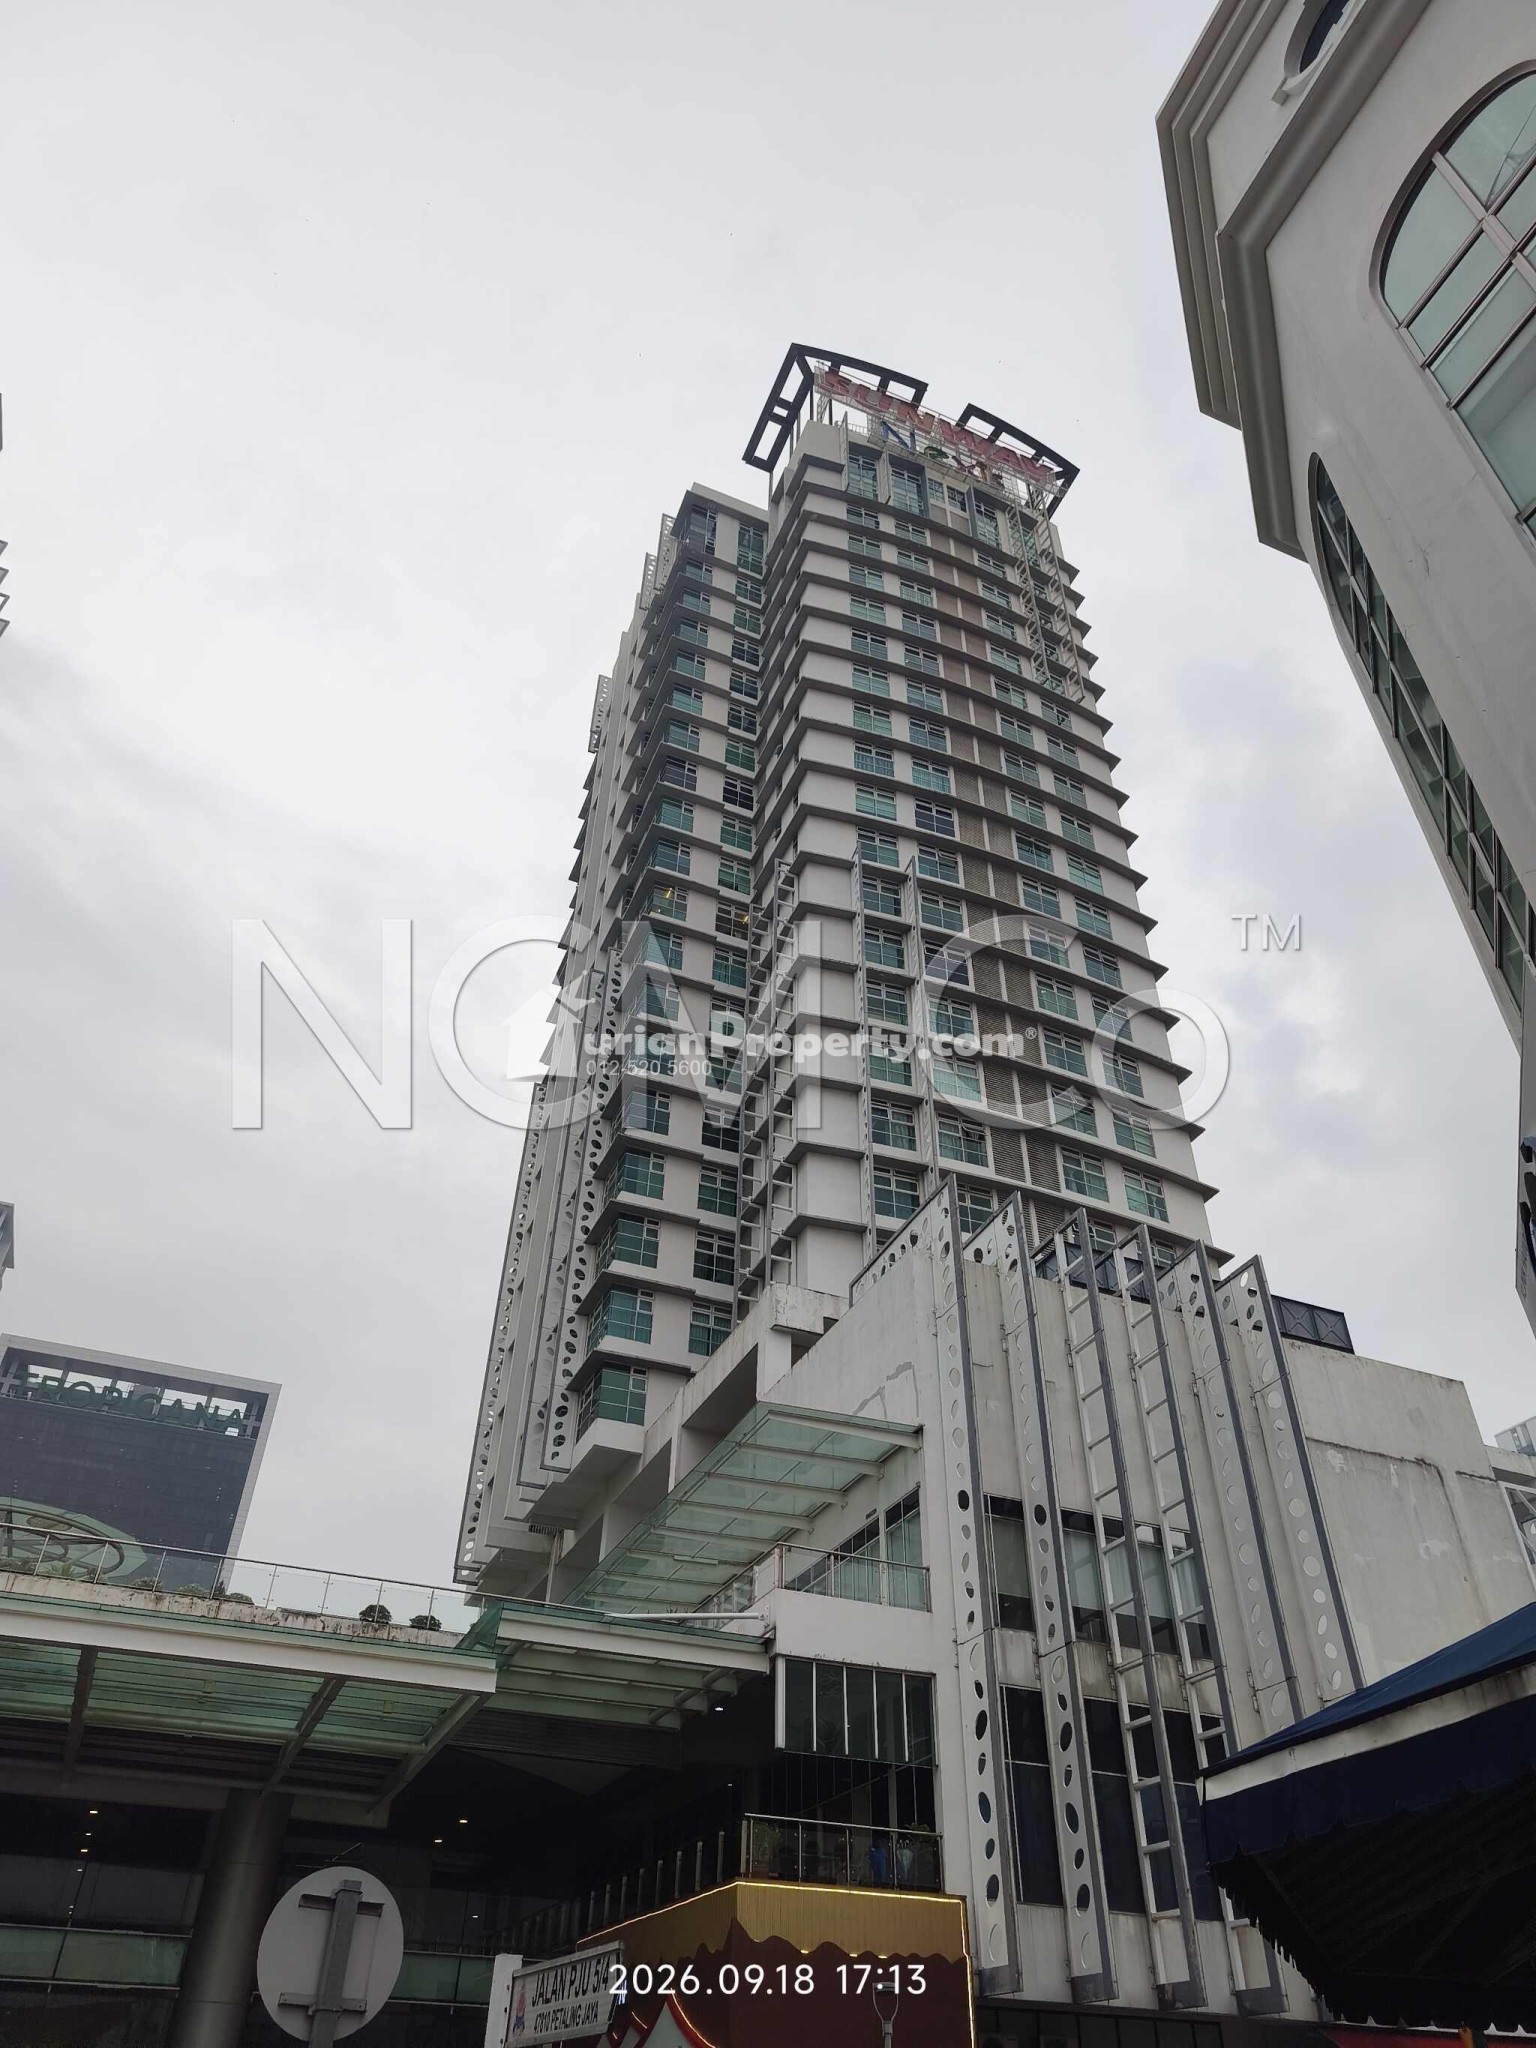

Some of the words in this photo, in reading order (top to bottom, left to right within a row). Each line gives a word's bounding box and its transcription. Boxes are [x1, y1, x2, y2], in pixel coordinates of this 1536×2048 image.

[16, 1368, 246, 1431] TROPICANA
[532, 1966, 568, 2008] JALAN
[567, 1960, 592, 2000] PJU
[592, 1954, 611, 1994] 5/4
[550, 2003, 582, 2031] PETALING
[582, 1999, 599, 2025] JAYA
